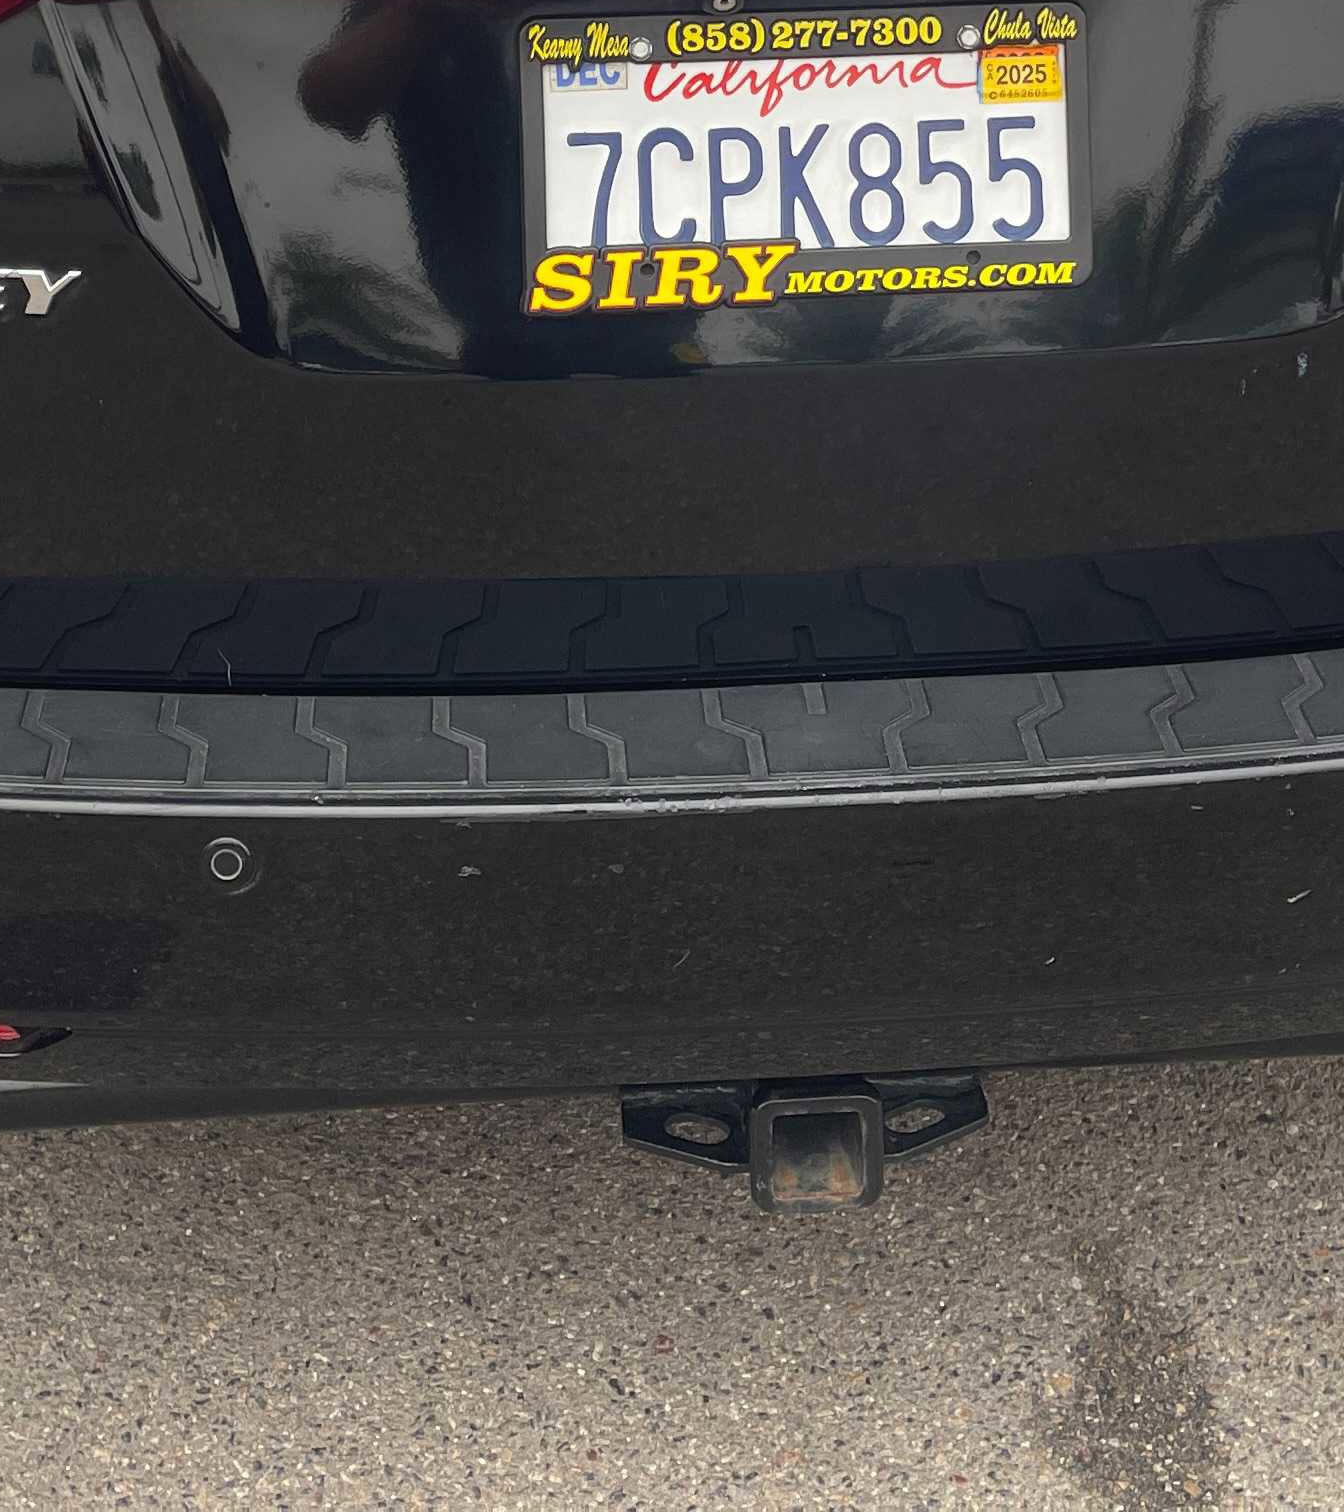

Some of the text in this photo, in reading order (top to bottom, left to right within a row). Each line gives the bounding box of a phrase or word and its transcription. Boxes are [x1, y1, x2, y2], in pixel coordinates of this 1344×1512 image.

[528, 22, 630, 66] Kearny Mesa
[667, 15, 942, 55] (858) 277-7300
[983, 7, 1078, 45] Chula Vista
[643, 57, 978, 117] California
[996, 64, 1047, 85] 2025
[567, 115, 1045, 248] 7CPK855
[530, 243, 1077, 313] SIRY MOTORS.COM
